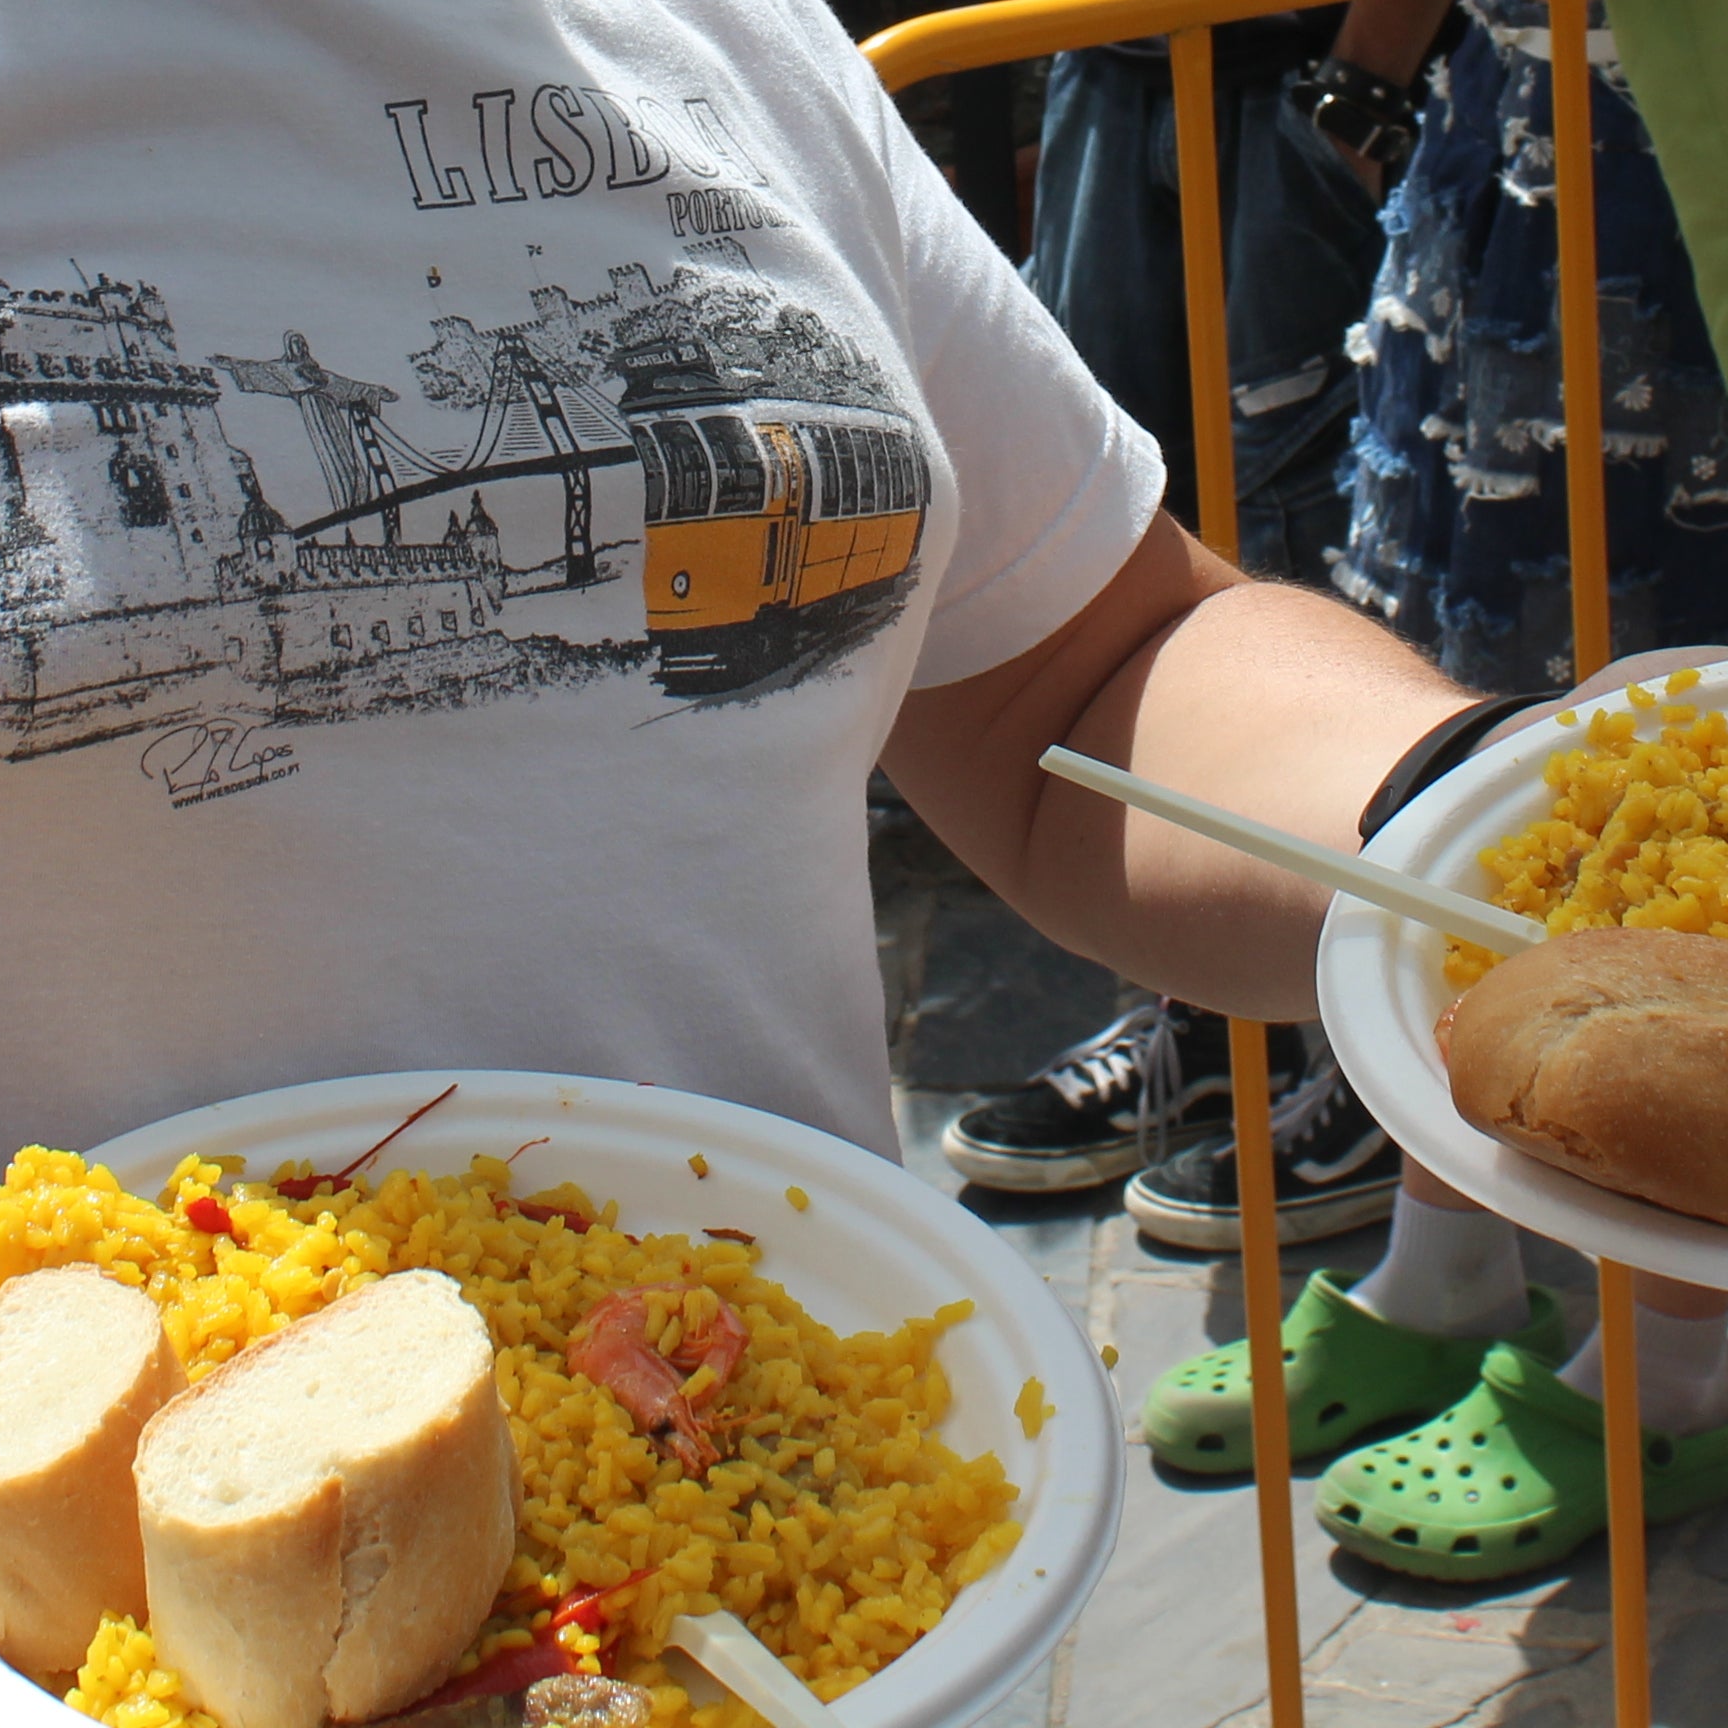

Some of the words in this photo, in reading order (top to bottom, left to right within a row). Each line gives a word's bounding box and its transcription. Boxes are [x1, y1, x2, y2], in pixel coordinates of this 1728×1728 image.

[385, 83, 768, 210] LISBOA
[625, 352, 672, 368] CASTELO
[678, 344, 697, 362] 28
